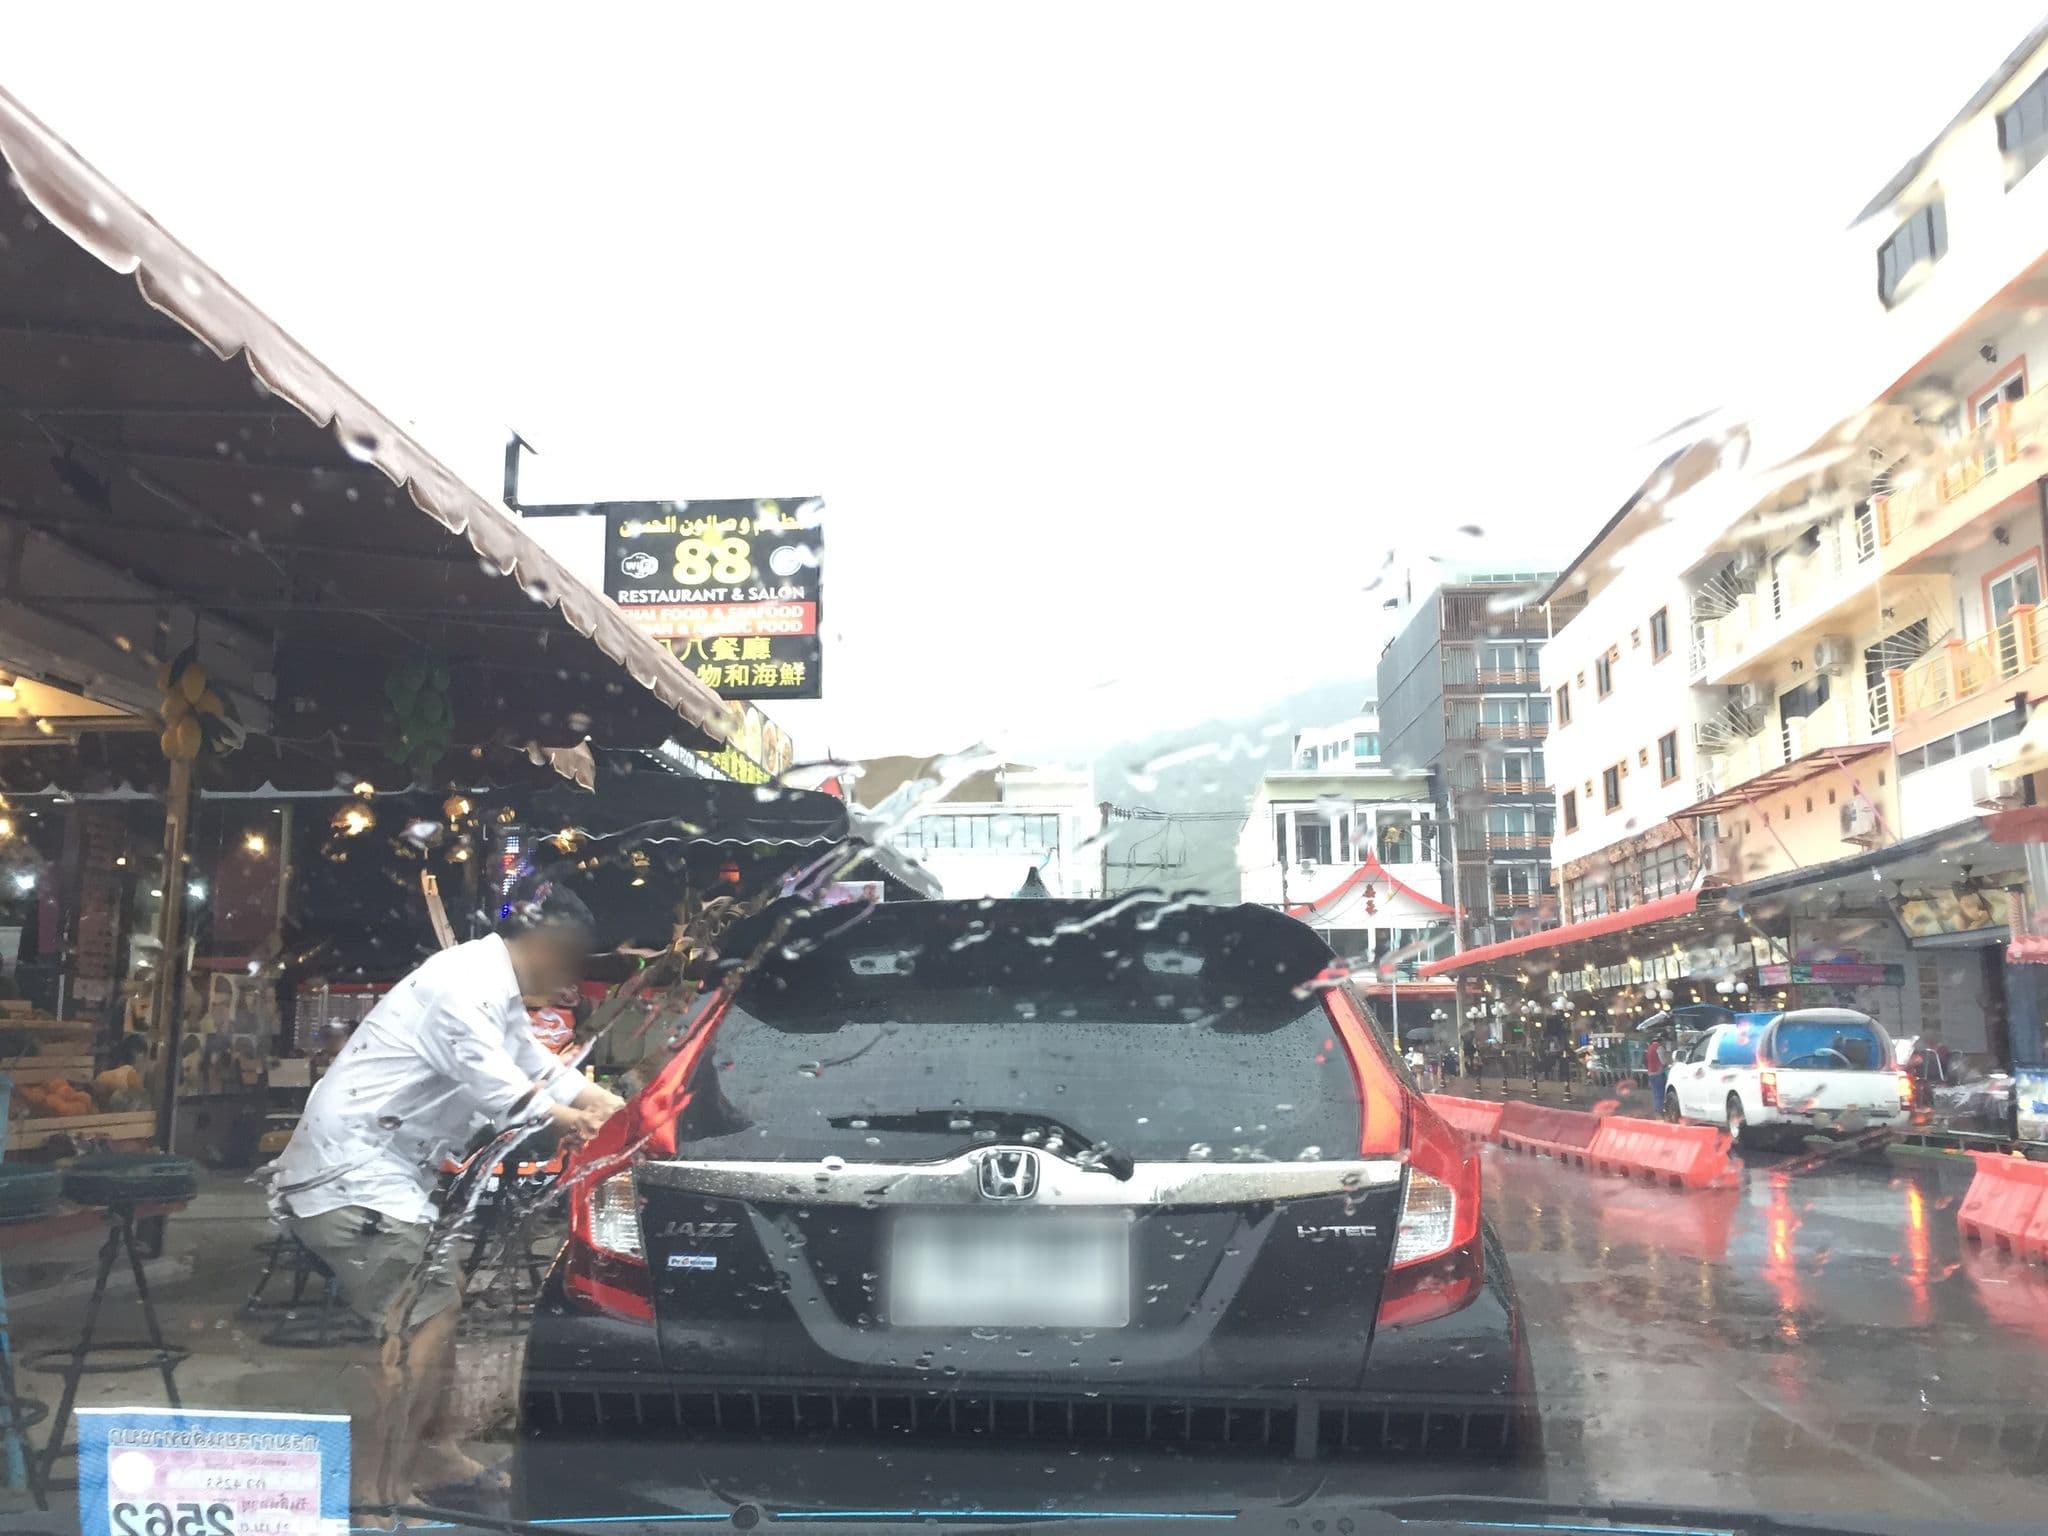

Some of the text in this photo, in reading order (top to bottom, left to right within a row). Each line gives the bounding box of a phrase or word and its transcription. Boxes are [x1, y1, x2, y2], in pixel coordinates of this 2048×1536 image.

[672, 537, 751, 585] 88
[617, 586, 806, 604] RESTAURANT & SALON
[660, 607, 707, 621] FOOD
[757, 619, 803, 633] FOOD
[658, 1221, 739, 1238] JAZZ
